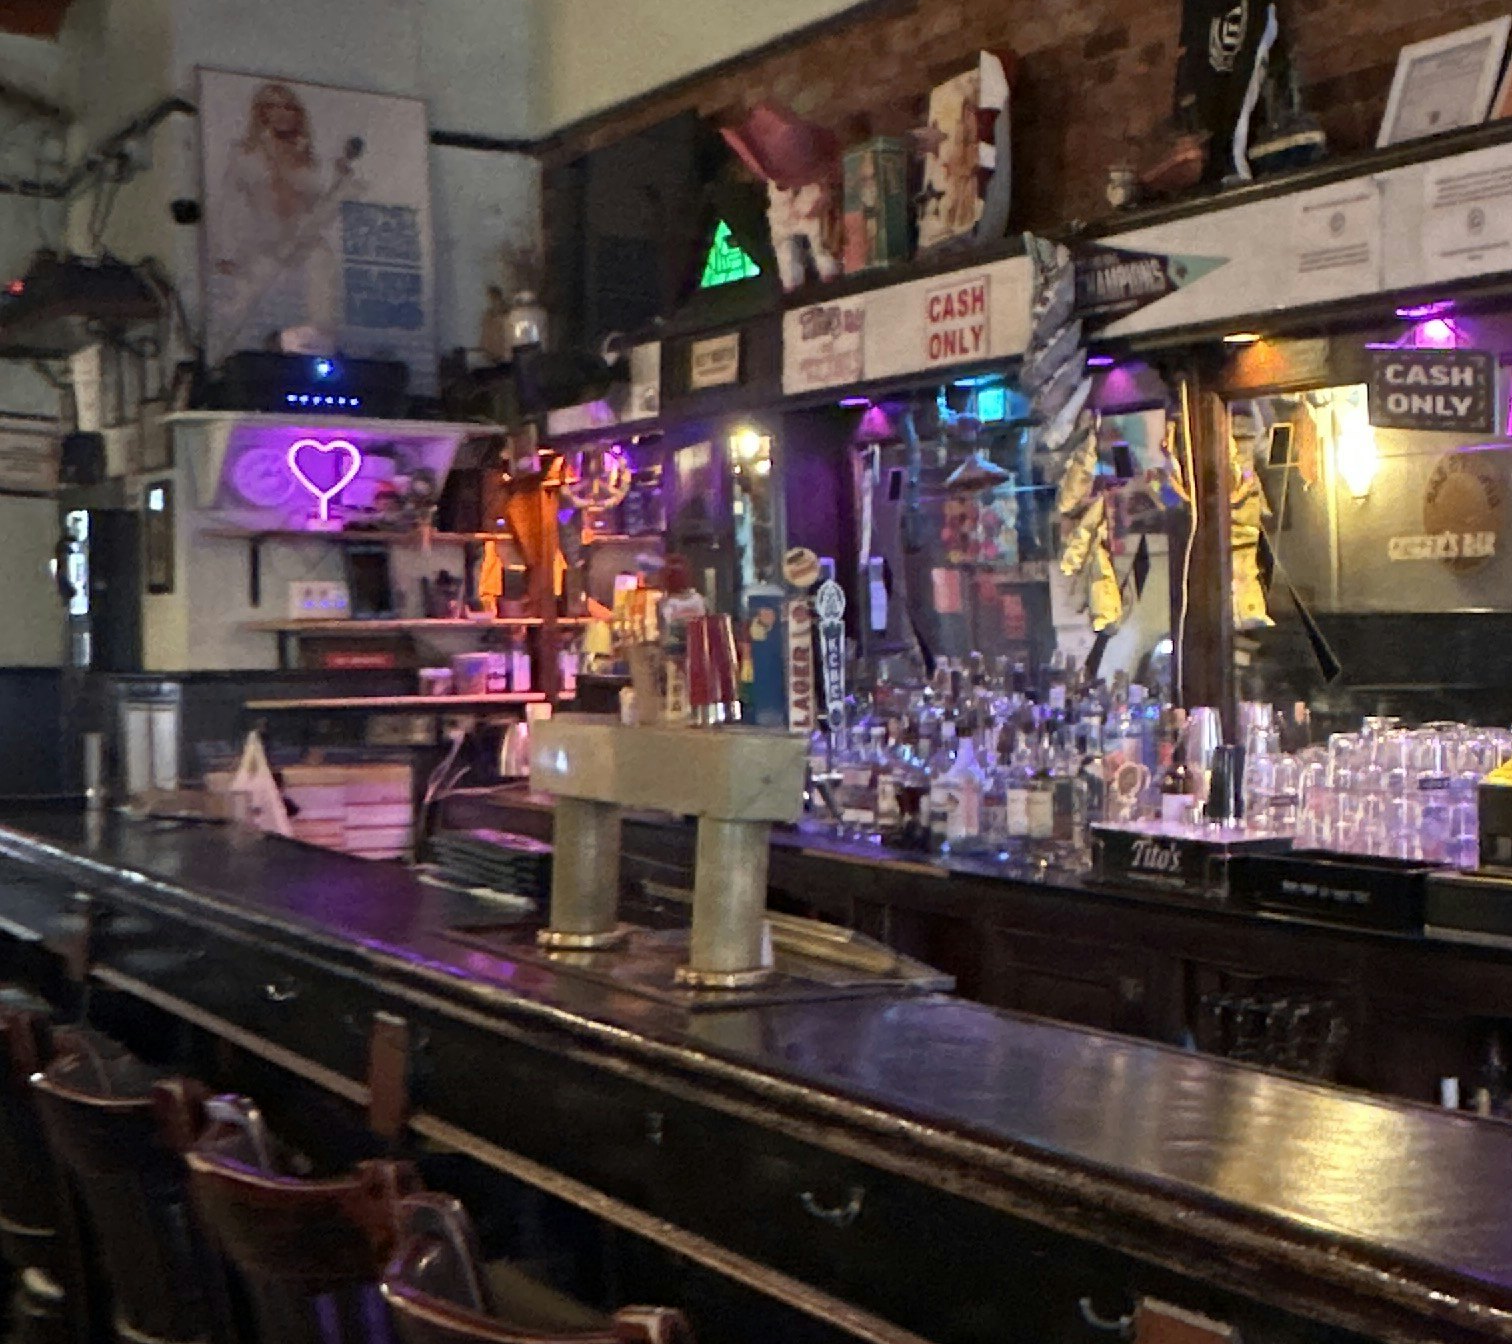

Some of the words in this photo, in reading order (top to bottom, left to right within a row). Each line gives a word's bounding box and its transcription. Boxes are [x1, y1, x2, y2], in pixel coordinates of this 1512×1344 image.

[928, 284, 985, 324] CASH
[928, 324, 984, 360] ONLY
[1384, 363, 1475, 388] CASH
[1385, 392, 1474, 417] ONLY
[792, 645, 812, 728] LAGER
[1130, 839, 1184, 873] Tito's
